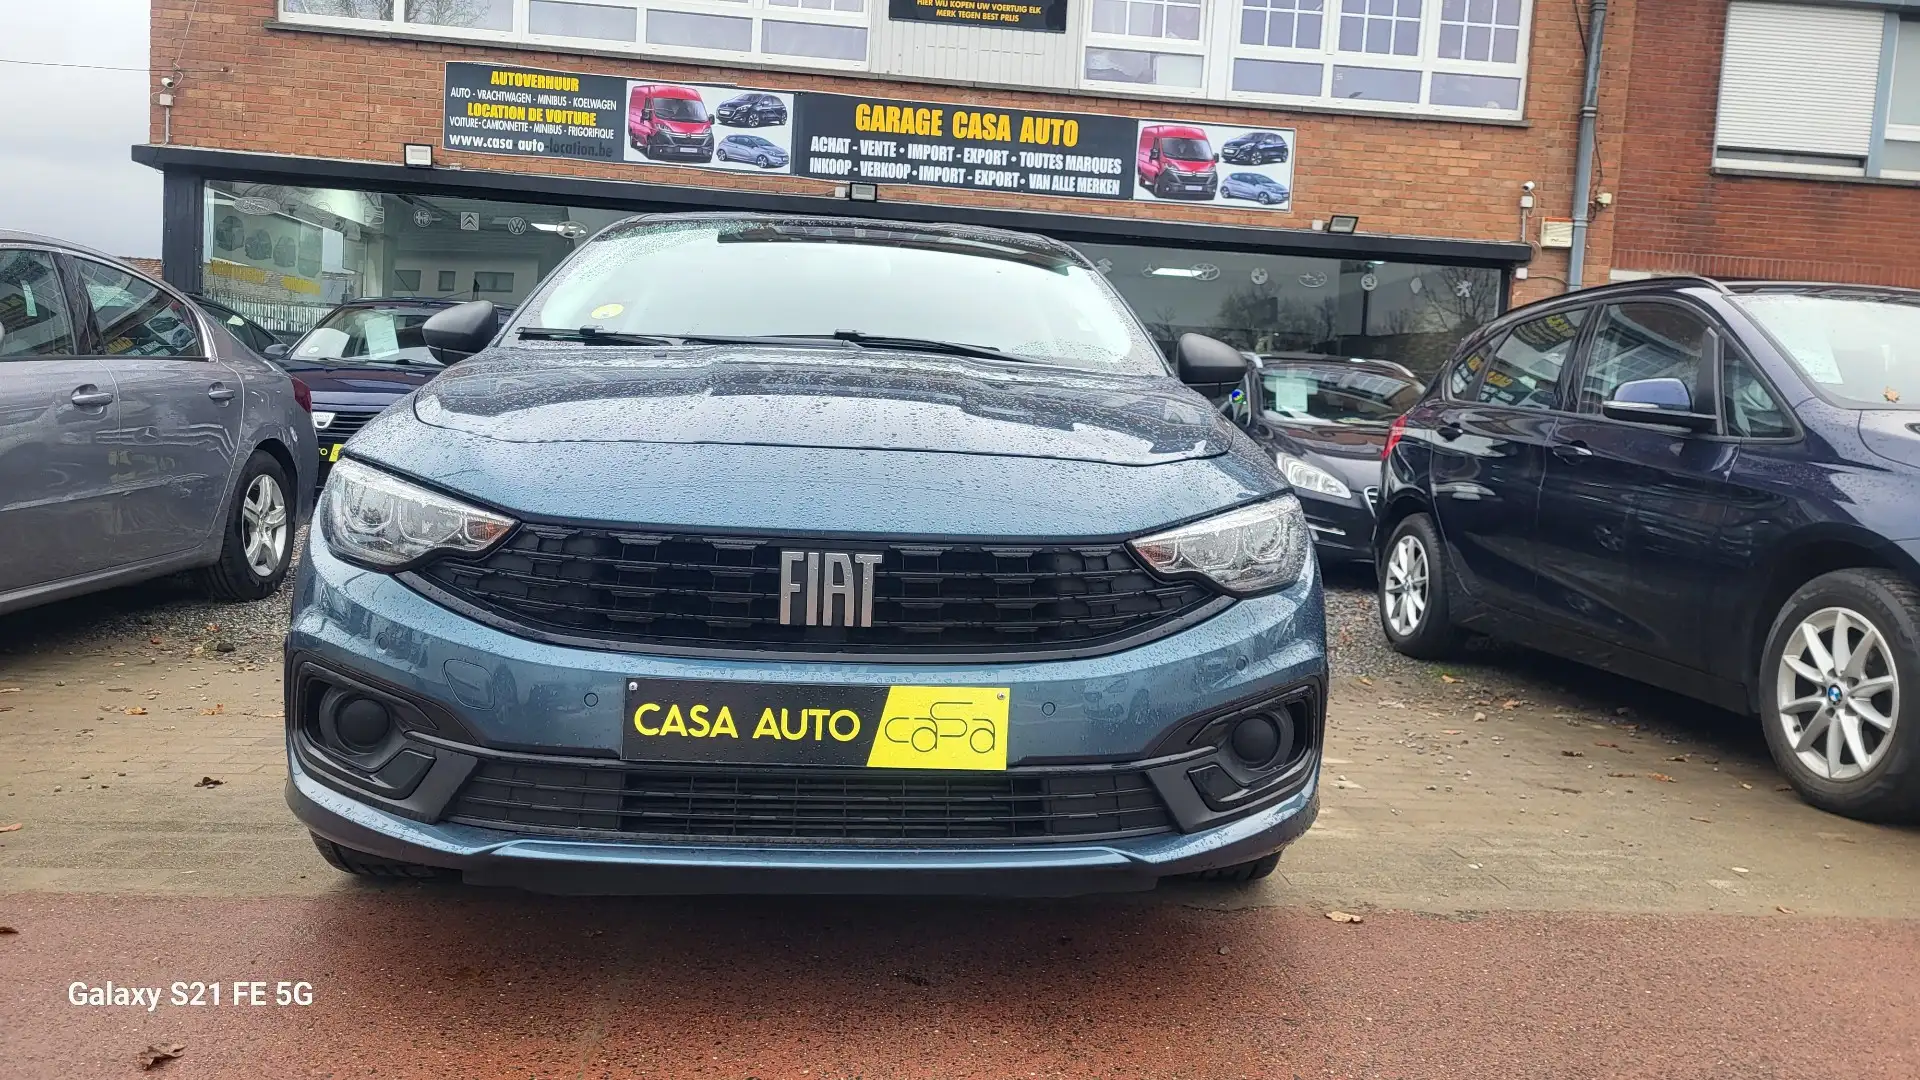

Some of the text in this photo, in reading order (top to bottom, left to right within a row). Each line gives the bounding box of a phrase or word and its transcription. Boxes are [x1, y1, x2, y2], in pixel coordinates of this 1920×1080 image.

[936, 9, 1019, 22] MERK TEGEN BEST PRIJS
[950, 0, 975, 9] KOPEN
[977, 2, 990, 10] UW
[992, 3, 1027, 13] VOERTUIG
[1029, 6, 1041, 14] ELK
[491, 71, 579, 92] AUTOVERHUUR
[451, 87, 617, 111] AUTO VRACHTWAGEN MINIBUS KOELWAGEN
[467, 102, 597, 127] LOCATION DE VOITURE
[855, 103, 1079, 147] GARAGE CASA AUTO
[534, 123, 562, 135] MINIBUS
[568, 125, 614, 140] FRIGORIFIQUE
[810, 136, 1122, 175] ACHAT VENTE IMPORT EXPORT TOUTES MARQUES
[809, 157, 1120, 195] INKOOP VERKOOP IMPORT EXPORT VAN ALLE MERKEN
[779, 551, 883, 627] FIAT
[633, 703, 738, 739] CASA
[752, 707, 861, 742] AUTO
